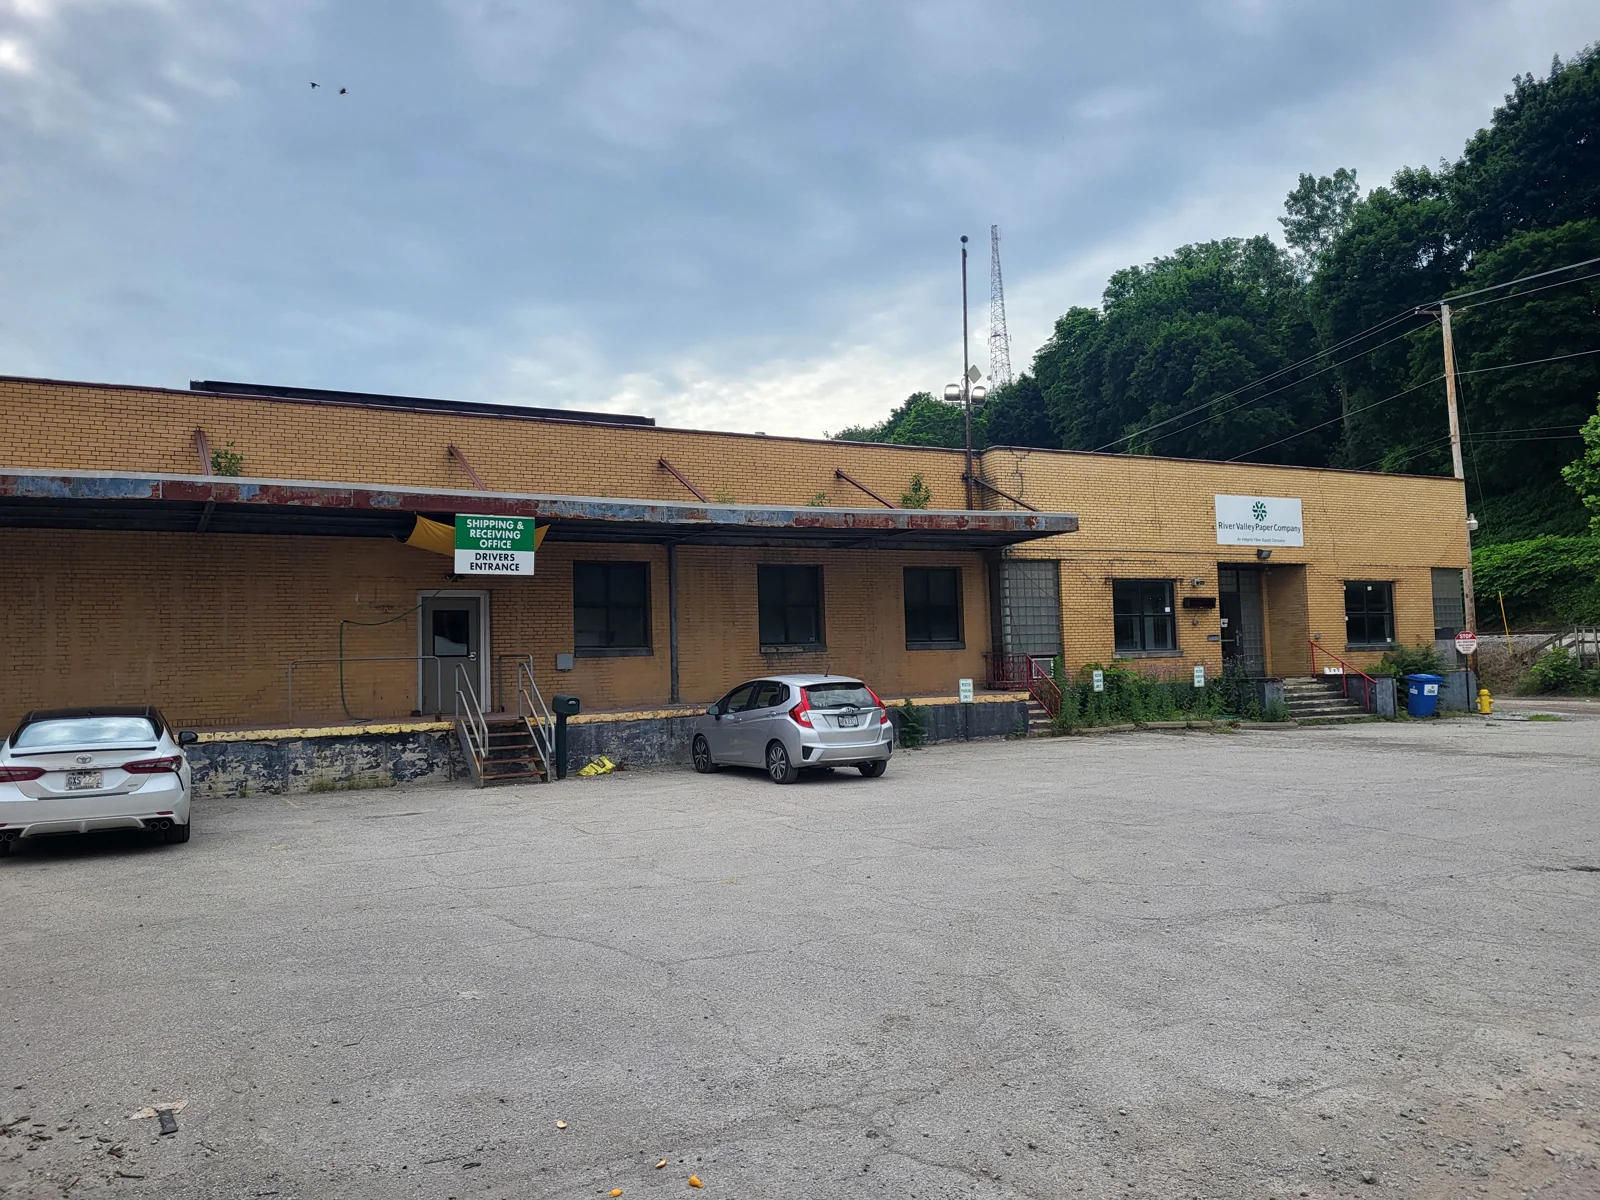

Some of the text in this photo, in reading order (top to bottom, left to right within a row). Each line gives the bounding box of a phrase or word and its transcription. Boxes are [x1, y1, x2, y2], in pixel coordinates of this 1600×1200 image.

[466, 519, 524, 530] SHIPPING &
[1218, 522, 1301, 534] River Valley Paper Company
[470, 530, 520, 539] RECEIVING
[480, 540, 512, 548] OFFICE
[475, 553, 515, 561] DRIVERS
[470, 562, 520, 571] ENTRANCE
